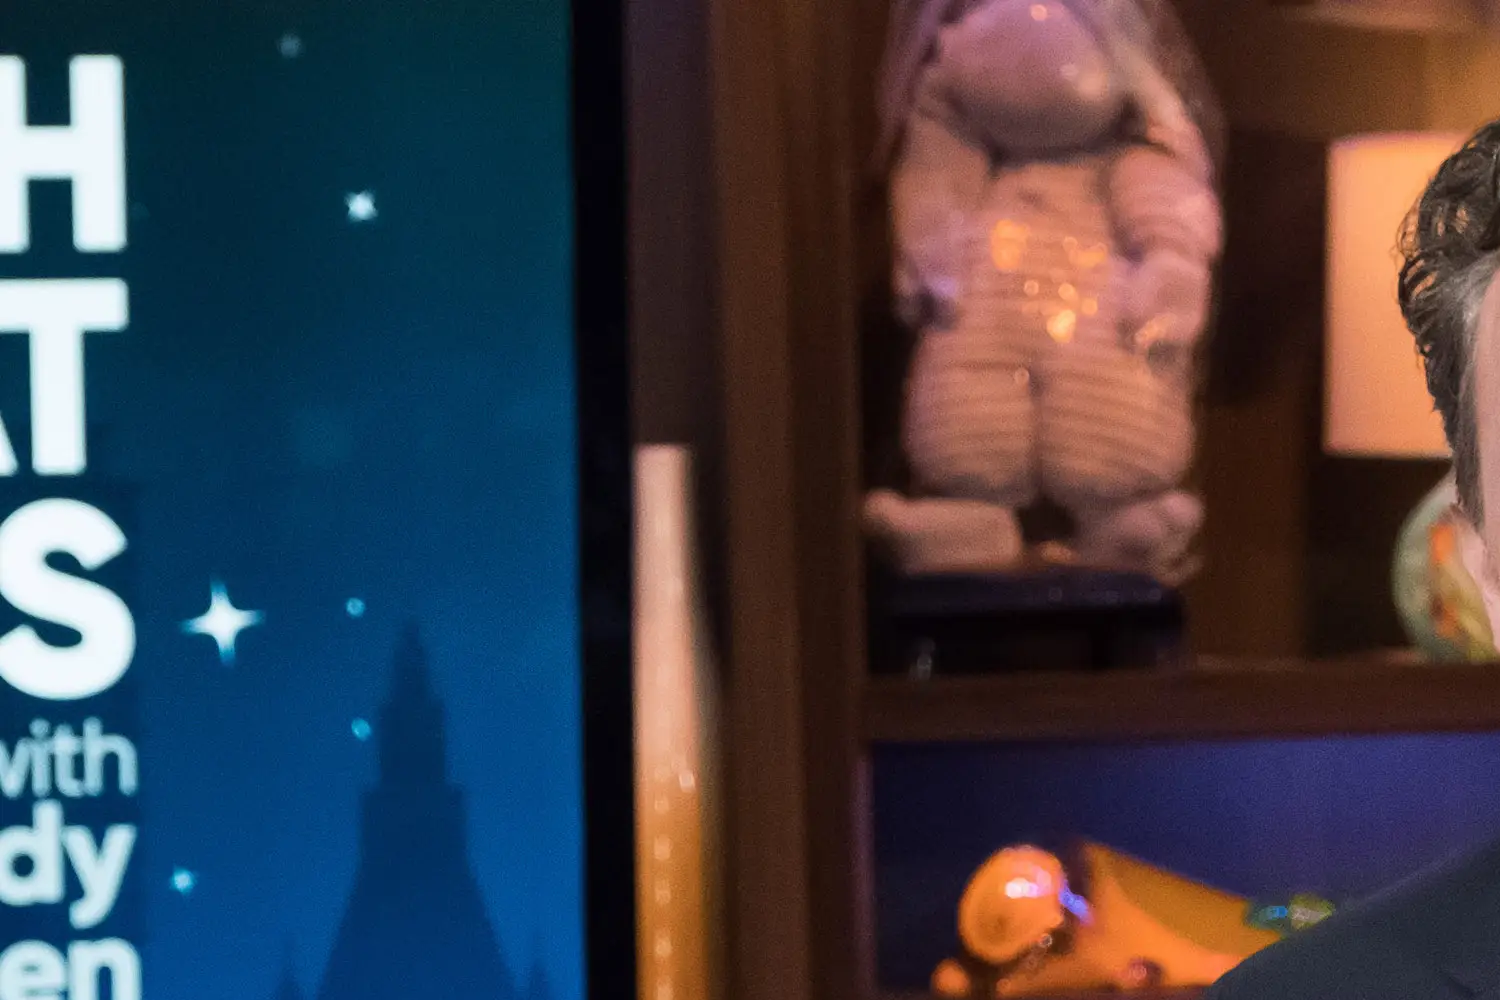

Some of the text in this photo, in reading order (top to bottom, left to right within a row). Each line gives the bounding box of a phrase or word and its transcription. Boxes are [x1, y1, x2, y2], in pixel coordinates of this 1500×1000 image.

[0, 53, 127, 253] H
[0, 277, 129, 476] T
[0, 497, 136, 700] S
[0, 799, 136, 929] dy
